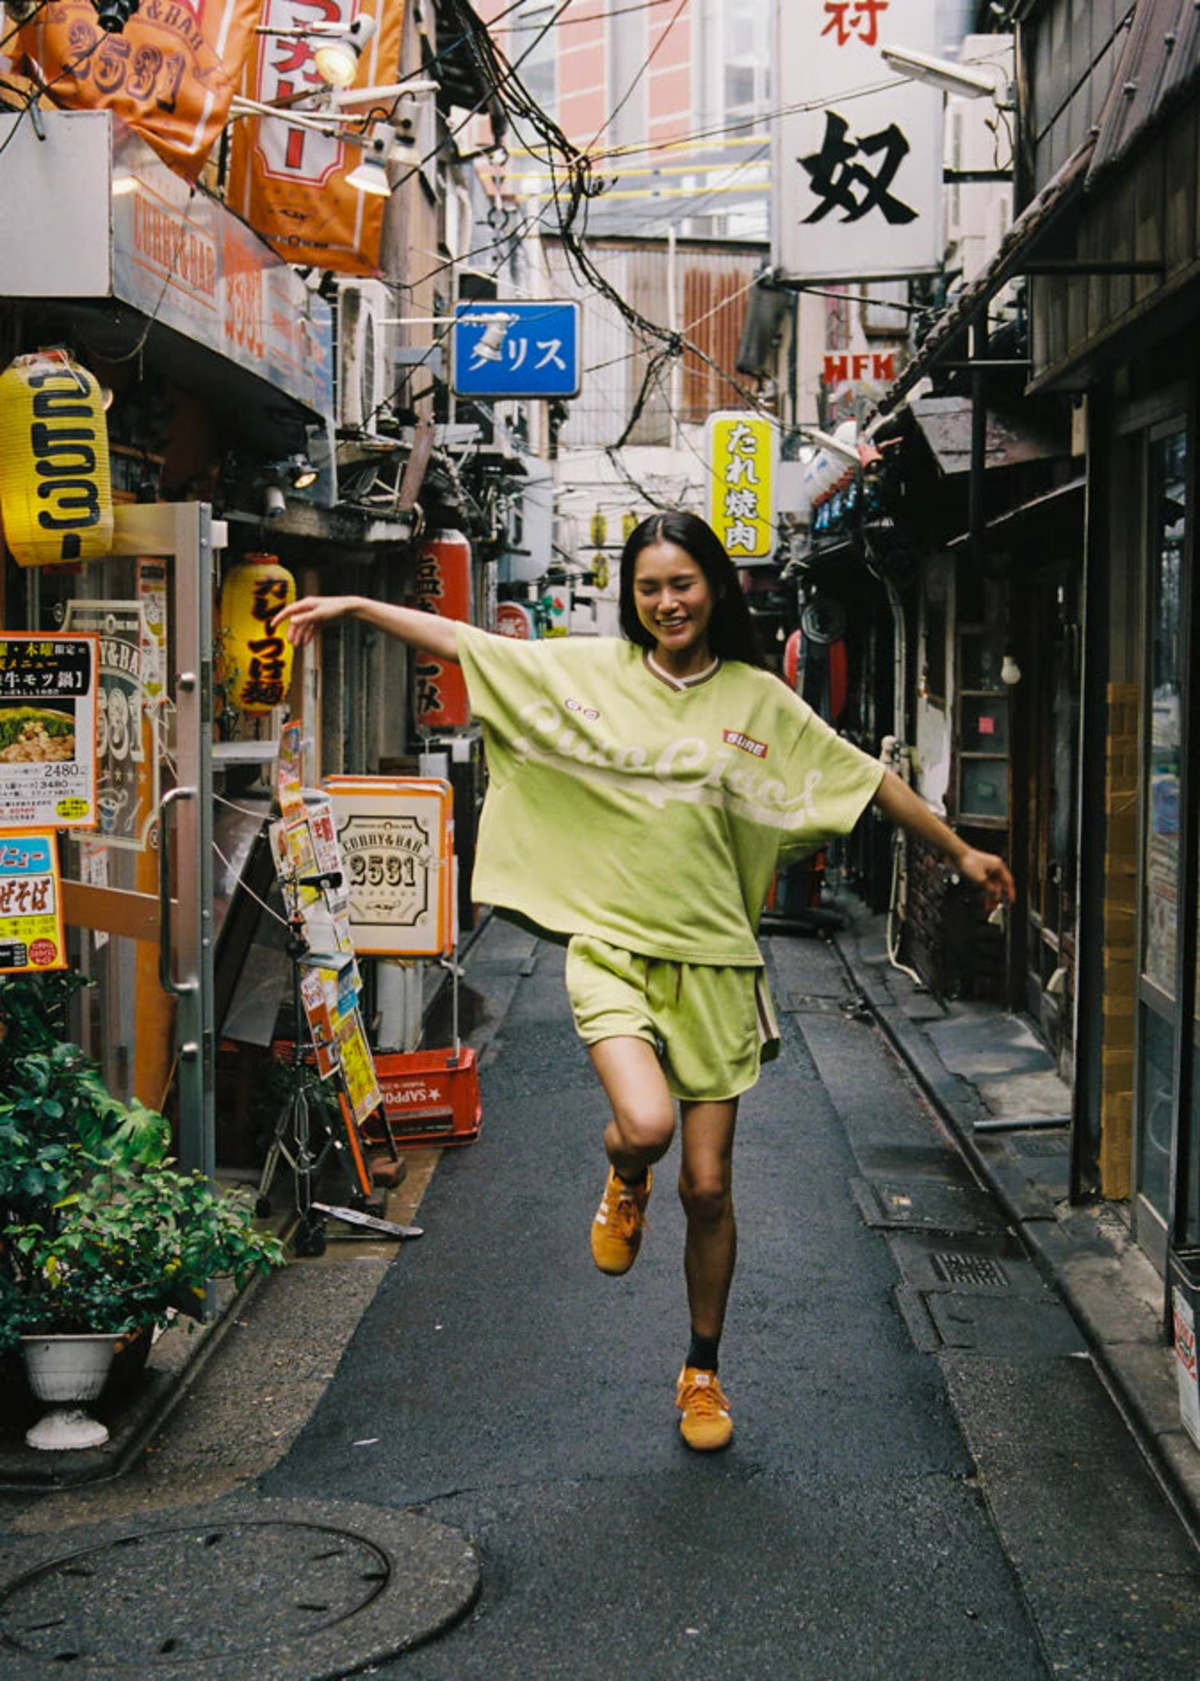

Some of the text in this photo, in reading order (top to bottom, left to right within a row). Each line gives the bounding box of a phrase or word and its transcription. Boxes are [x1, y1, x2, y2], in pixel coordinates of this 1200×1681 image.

[798, 111, 919, 225] 奴
[724, 424, 758, 552] たれ焼肉
[44, 763, 80, 777] 2480
